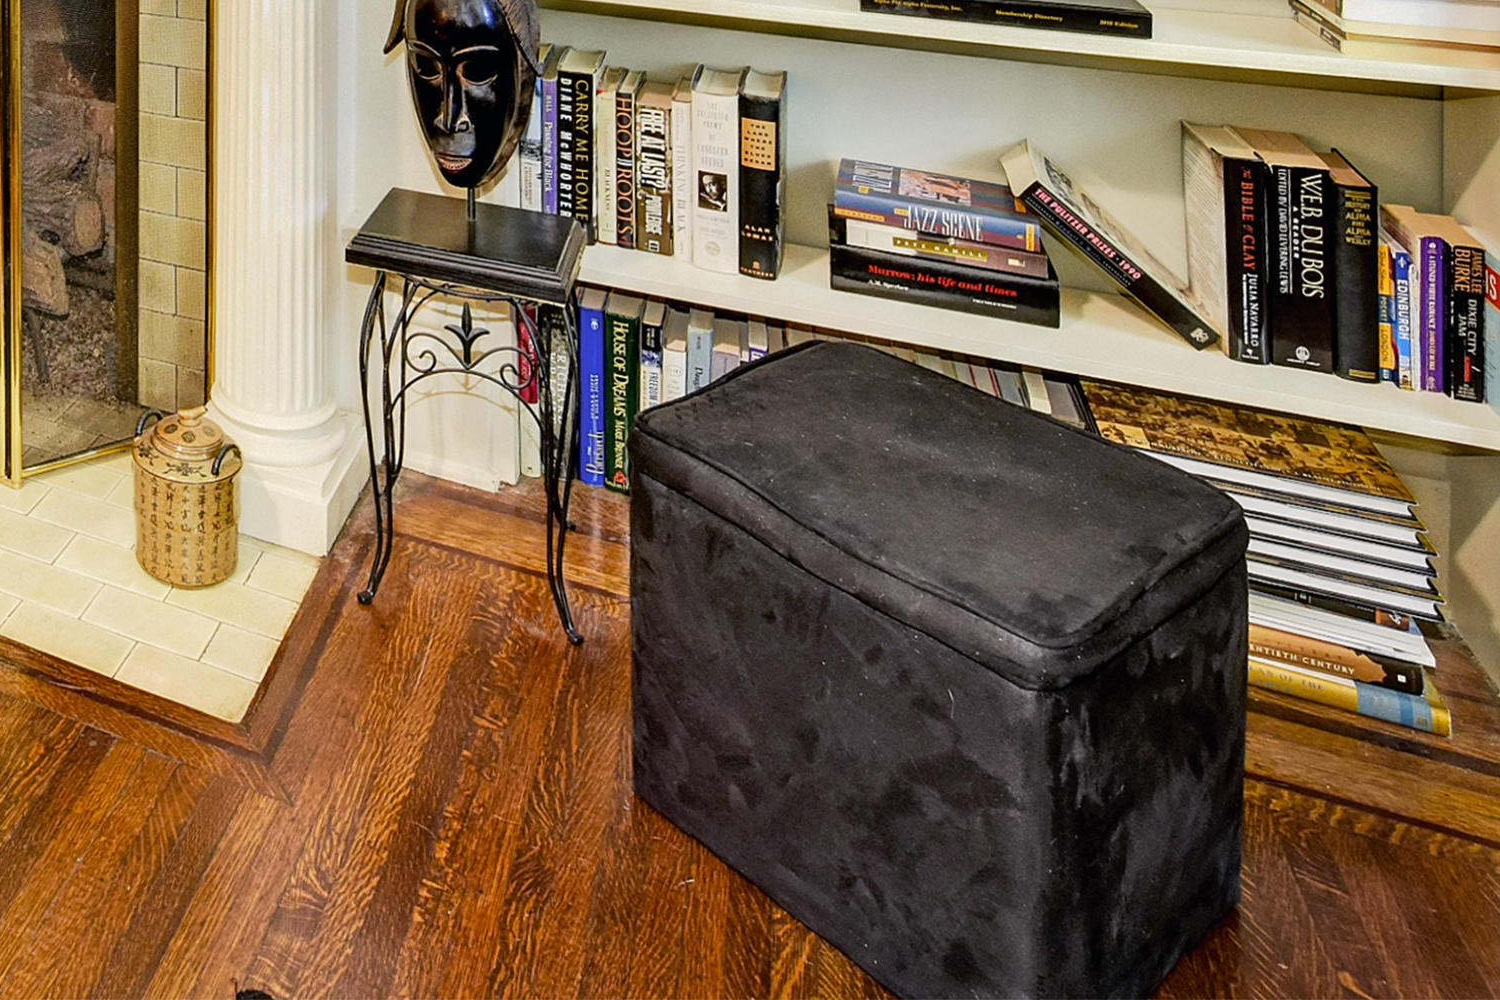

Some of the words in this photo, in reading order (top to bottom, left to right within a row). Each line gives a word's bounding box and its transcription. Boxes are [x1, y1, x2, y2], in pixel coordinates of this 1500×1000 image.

[996, 9, 1033, 20] Membership
[1034, 12, 1063, 23] Directory
[559, 77, 573, 122] DIANE
[575, 79, 589, 134] CARRY
[616, 97, 633, 158] HOOP
[640, 108, 666, 134] FREE
[544, 122, 553, 152] Passing
[575, 137, 589, 161] ME
[641, 135, 665, 151] AT
[544, 155, 553, 168] for
[560, 130, 573, 218] McWHORTER
[640, 153, 666, 189] LAST?
[676, 145, 686, 198] THINKING
[544, 169, 553, 192] Black
[575, 168, 590, 222] HOME
[1277, 168, 1287, 195] EDITED
[616, 167, 633, 236] ROOTS
[1241, 181, 1254, 221] BIBLE
[1278, 196, 1287, 205] BY
[1300, 174, 1322, 220] W.E.B.
[644, 194, 662, 236] POWLEDGE
[676, 199, 687, 233] BLACK
[744, 224, 771, 234] ALAN
[903, 205, 939, 233] JAZZ
[941, 211, 983, 242] SCENE
[1278, 208, 1288, 233] DAVID
[893, 238, 927, 249] PETE
[933, 244, 984, 258] HAMILL
[1035, 188, 1052, 204] THE
[1050, 201, 1088, 235] PULITZER
[1086, 231, 1117, 258] PRIZES
[1118, 259, 1142, 280] 1990
[1301, 225, 1323, 256] DU
[1242, 234, 1255, 271] CLAY
[1279, 234, 1288, 270] LEVERING
[1471, 250, 1483, 277] JAMES
[868, 265, 915, 280] Murrow:
[916, 273, 936, 283] his
[938, 276, 957, 288] life
[958, 281, 983, 291] and
[985, 284, 1018, 297] times
[1279, 271, 1289, 294] LEWIS
[1301, 258, 1324, 299] BOIS
[1454, 248, 1470, 292] BURKE
[1247, 273, 1259, 301] JULIA
[1472, 279, 1483, 295] LEE
[1249, 302, 1259, 347] NAVARRO
[1380, 296, 1388, 322] POCKET
[1398, 279, 1410, 340] EDINBURGH
[1468, 299, 1477, 328] DIXIE
[612, 320, 629, 355] HOUSE
[1458, 313, 1467, 337] JAM
[1381, 329, 1390, 362] LONDON
[1468, 330, 1477, 356] CITY
[613, 357, 629, 373] OF
[612, 373, 629, 418] DREAMS
[614, 441, 628, 469] BRENNER
[1302, 656, 1355, 675] CENTURY
